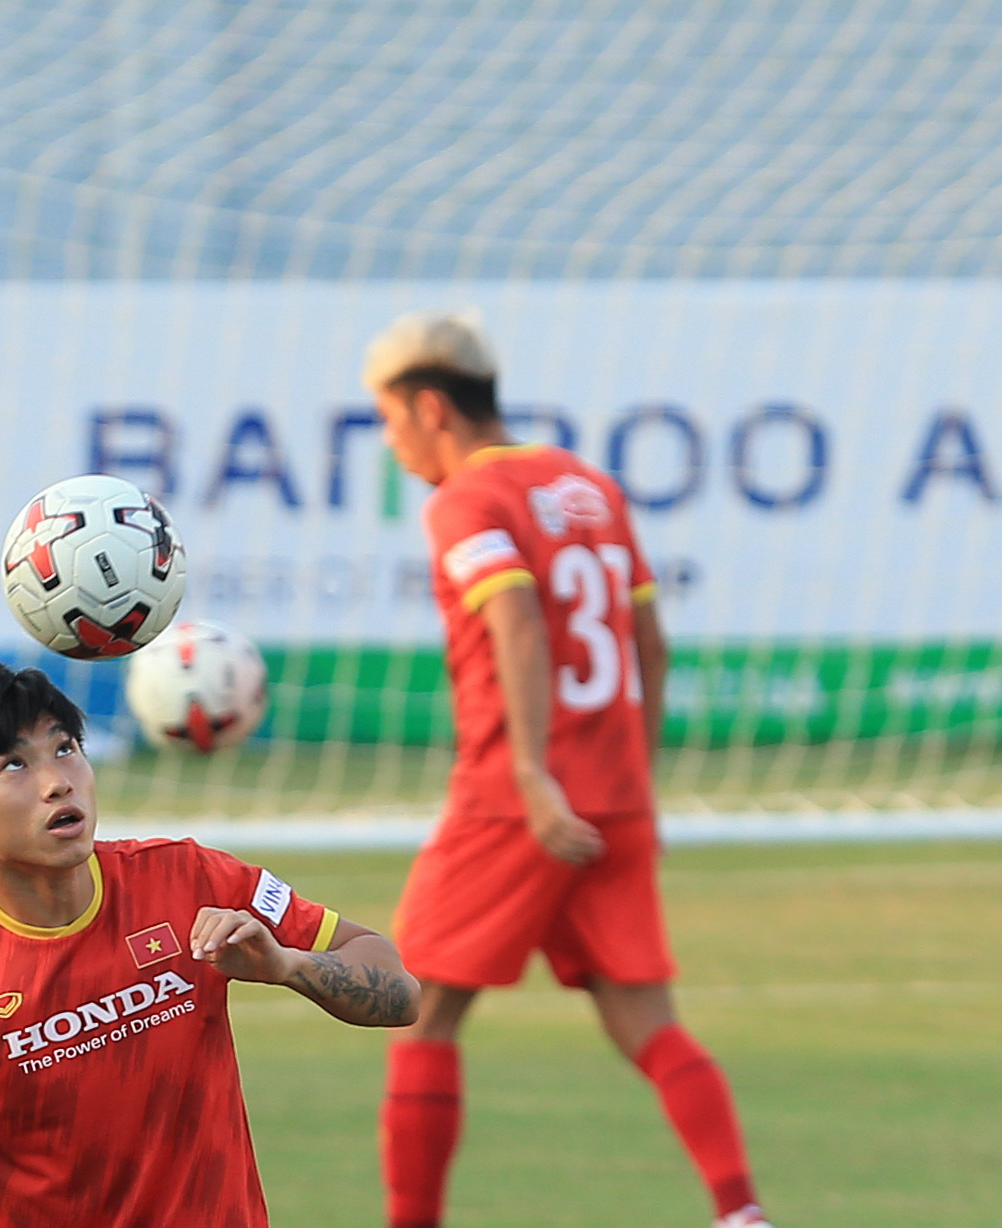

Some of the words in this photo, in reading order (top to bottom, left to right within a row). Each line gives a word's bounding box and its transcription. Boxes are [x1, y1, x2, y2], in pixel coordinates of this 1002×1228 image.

[2, 970, 195, 1060] HONDA
[18, 1054, 53, 1074] The
[53, 1034, 107, 1063] Power
[110, 1024, 129, 1043] of
[130, 999, 196, 1035] Dreams
